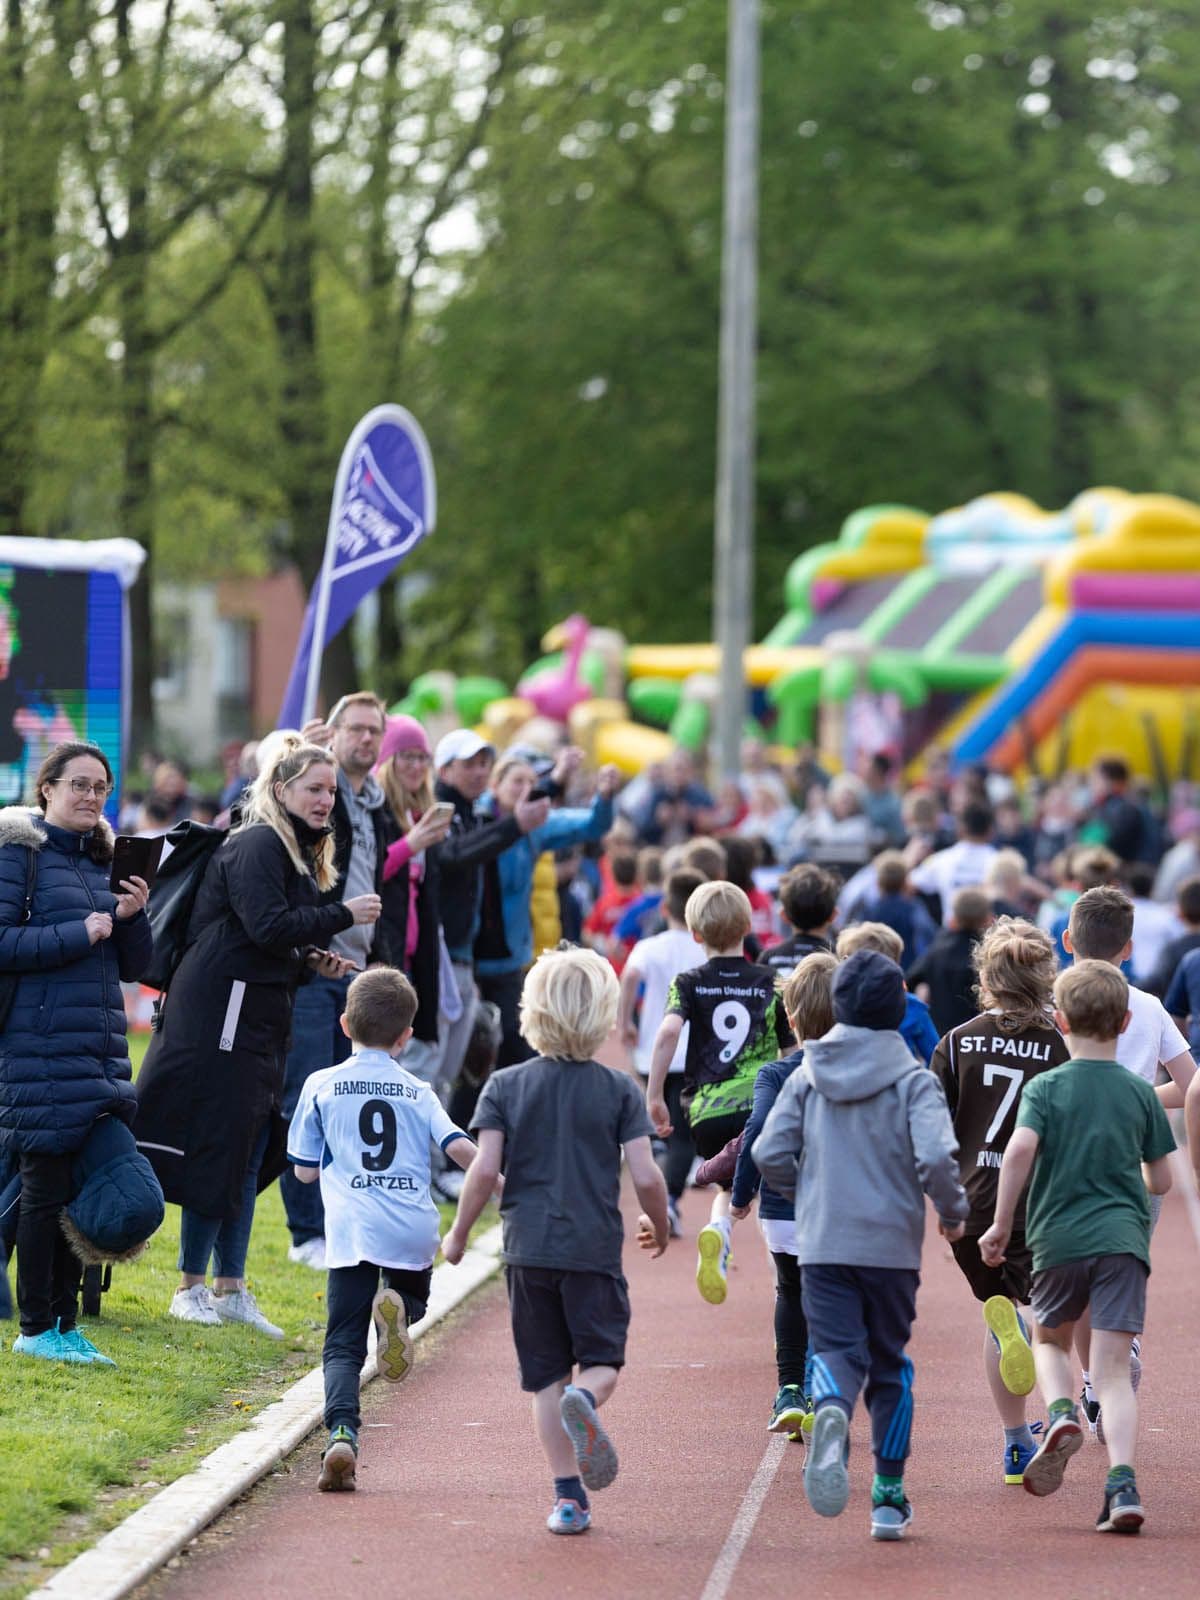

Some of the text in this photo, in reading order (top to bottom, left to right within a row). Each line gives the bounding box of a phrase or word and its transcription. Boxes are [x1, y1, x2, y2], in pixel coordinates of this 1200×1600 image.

[724, 986, 752, 997] United
[754, 988, 767, 998] FC
[712, 1000, 751, 1063] 9
[960, 1037, 1051, 1061] ST. PAULI
[334, 1081, 418, 1100] HAMBURGER SV
[983, 1064, 1024, 1143] 7
[358, 1099, 397, 1171] 9
